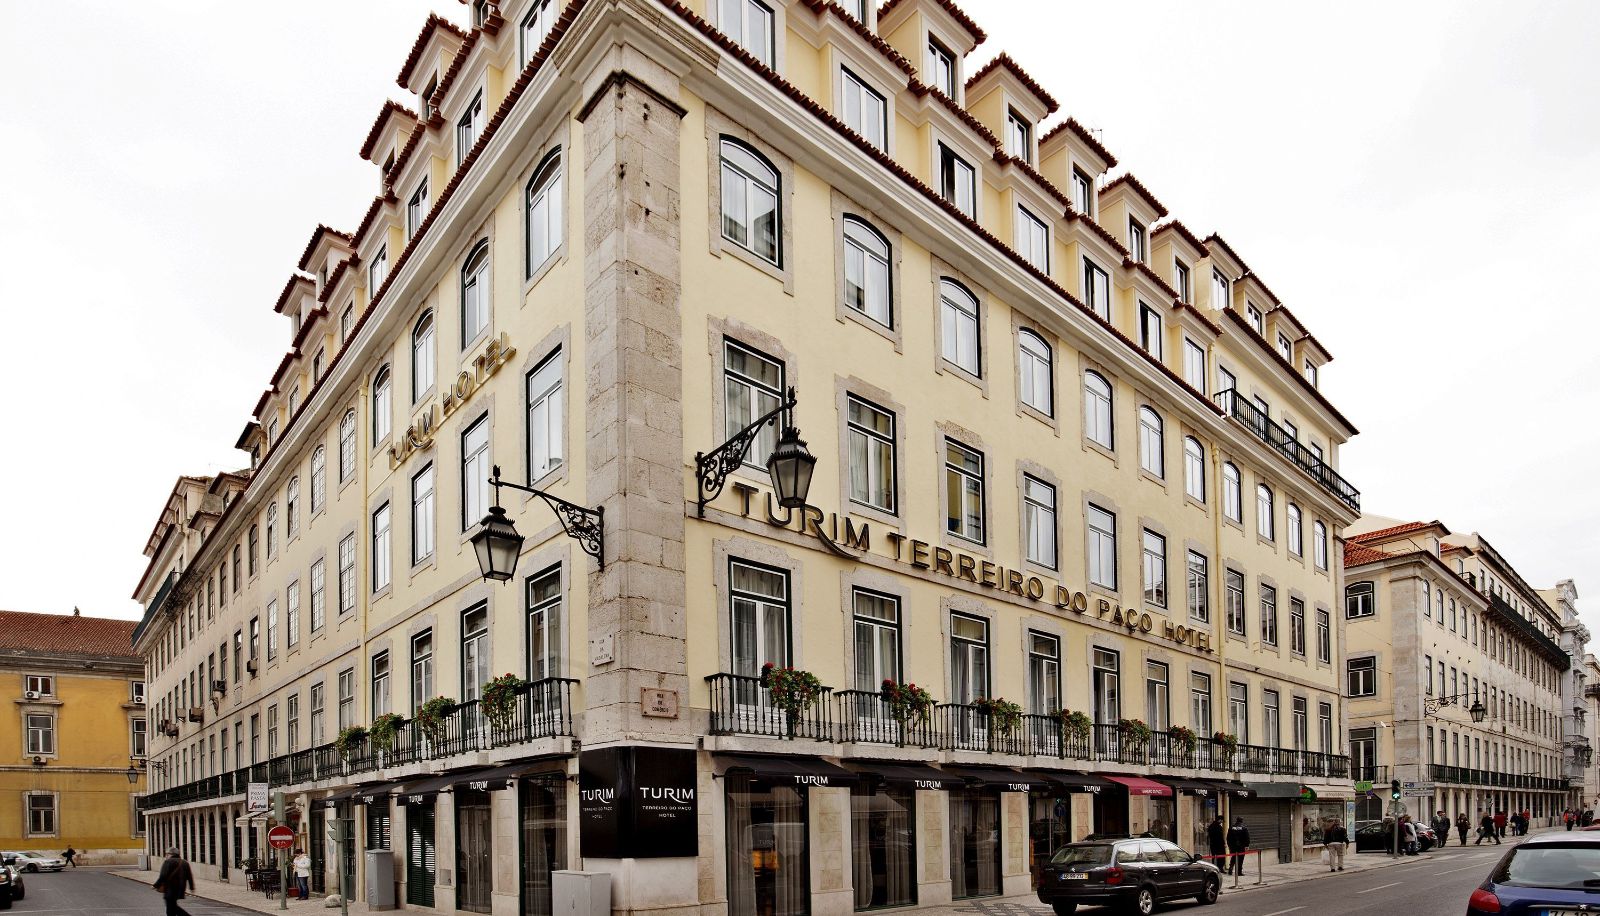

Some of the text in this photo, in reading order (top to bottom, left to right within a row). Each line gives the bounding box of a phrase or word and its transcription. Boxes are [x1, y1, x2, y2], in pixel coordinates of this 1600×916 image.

[387, 331, 517, 470] TURIM HOTEL
[732, 481, 1214, 652] TURIM TERREIRO DO PAÇO HOTEL
[469, 780, 489, 792] TURIM
[793, 775, 829, 788] TURIM
[914, 779, 942, 791] TURIM
[1008, 783, 1030, 793] TURIM
[581, 787, 614, 804] TURIM
[639, 787, 694, 804] TURIM
[1083, 785, 1101, 794] TURIM
